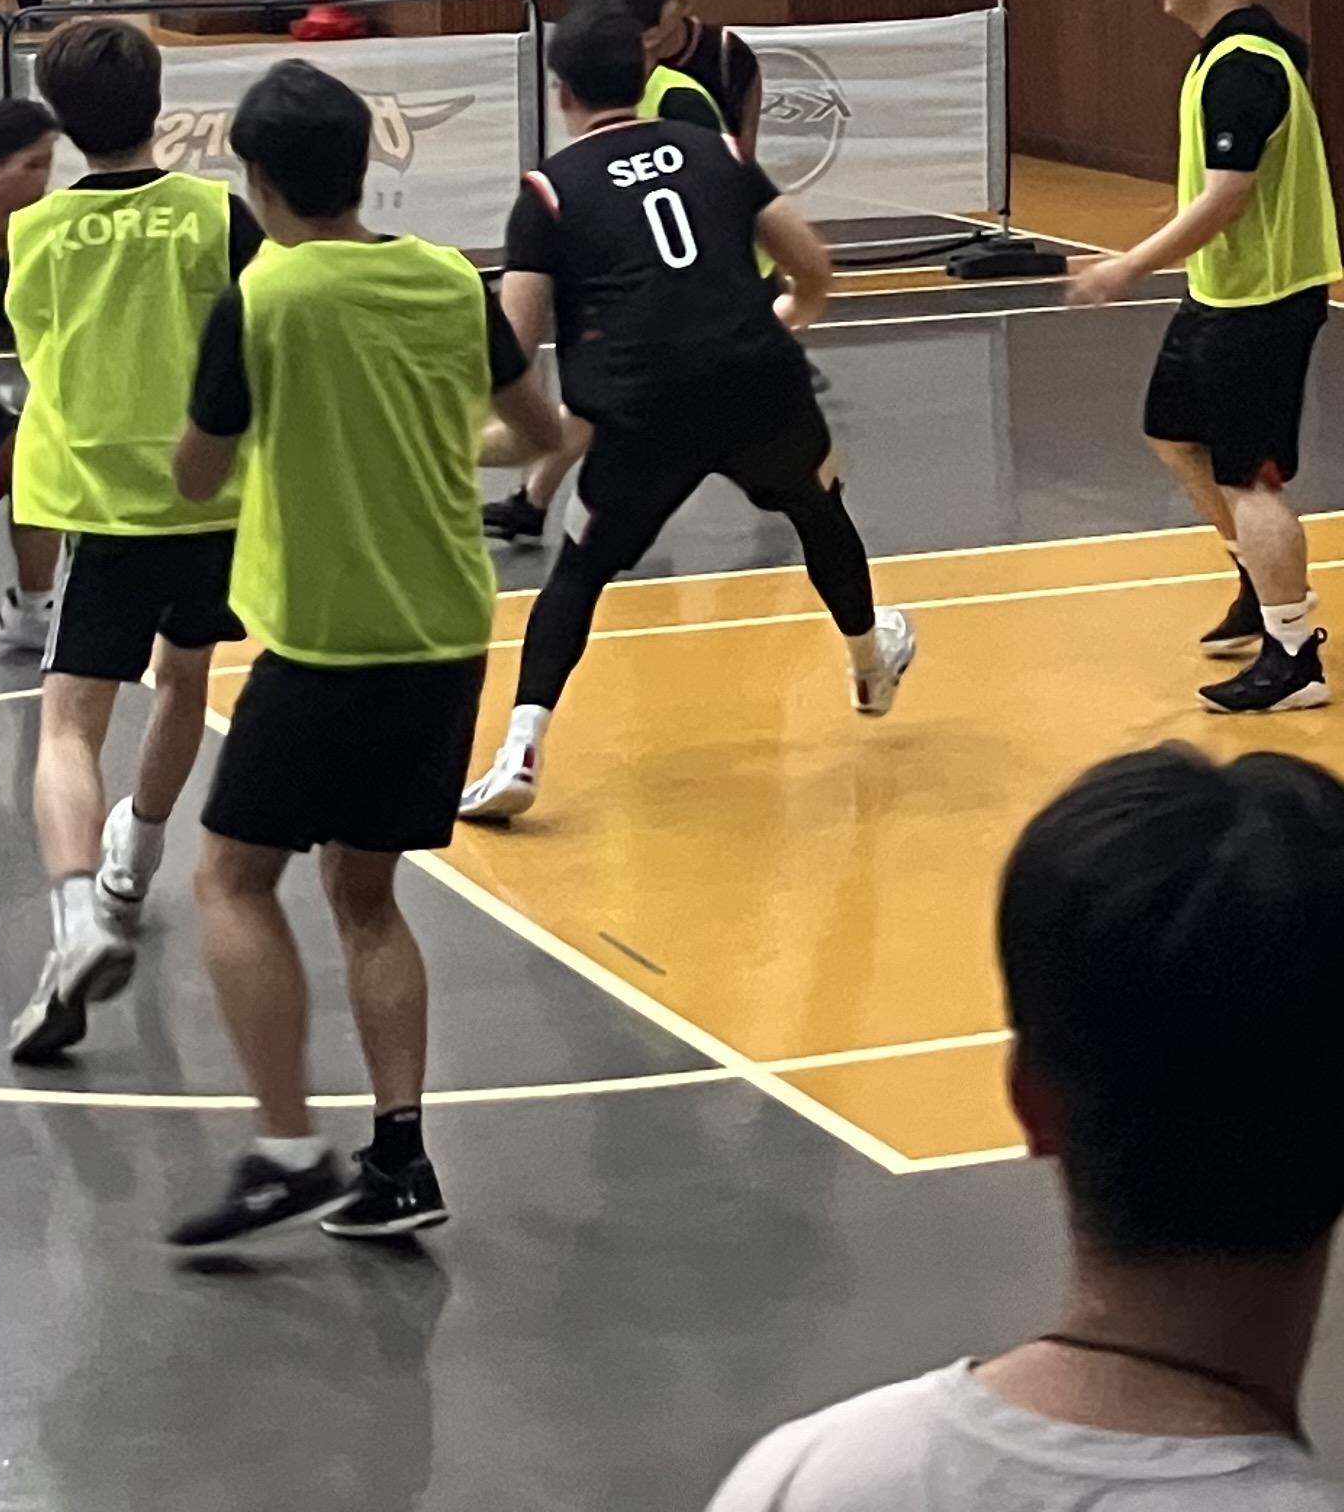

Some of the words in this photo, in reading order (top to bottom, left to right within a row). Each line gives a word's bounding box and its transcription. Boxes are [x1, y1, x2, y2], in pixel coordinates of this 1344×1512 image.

[607, 144, 684, 188] SEO
[48, 206, 200, 260] KOREA
[642, 188, 698, 269] 0
